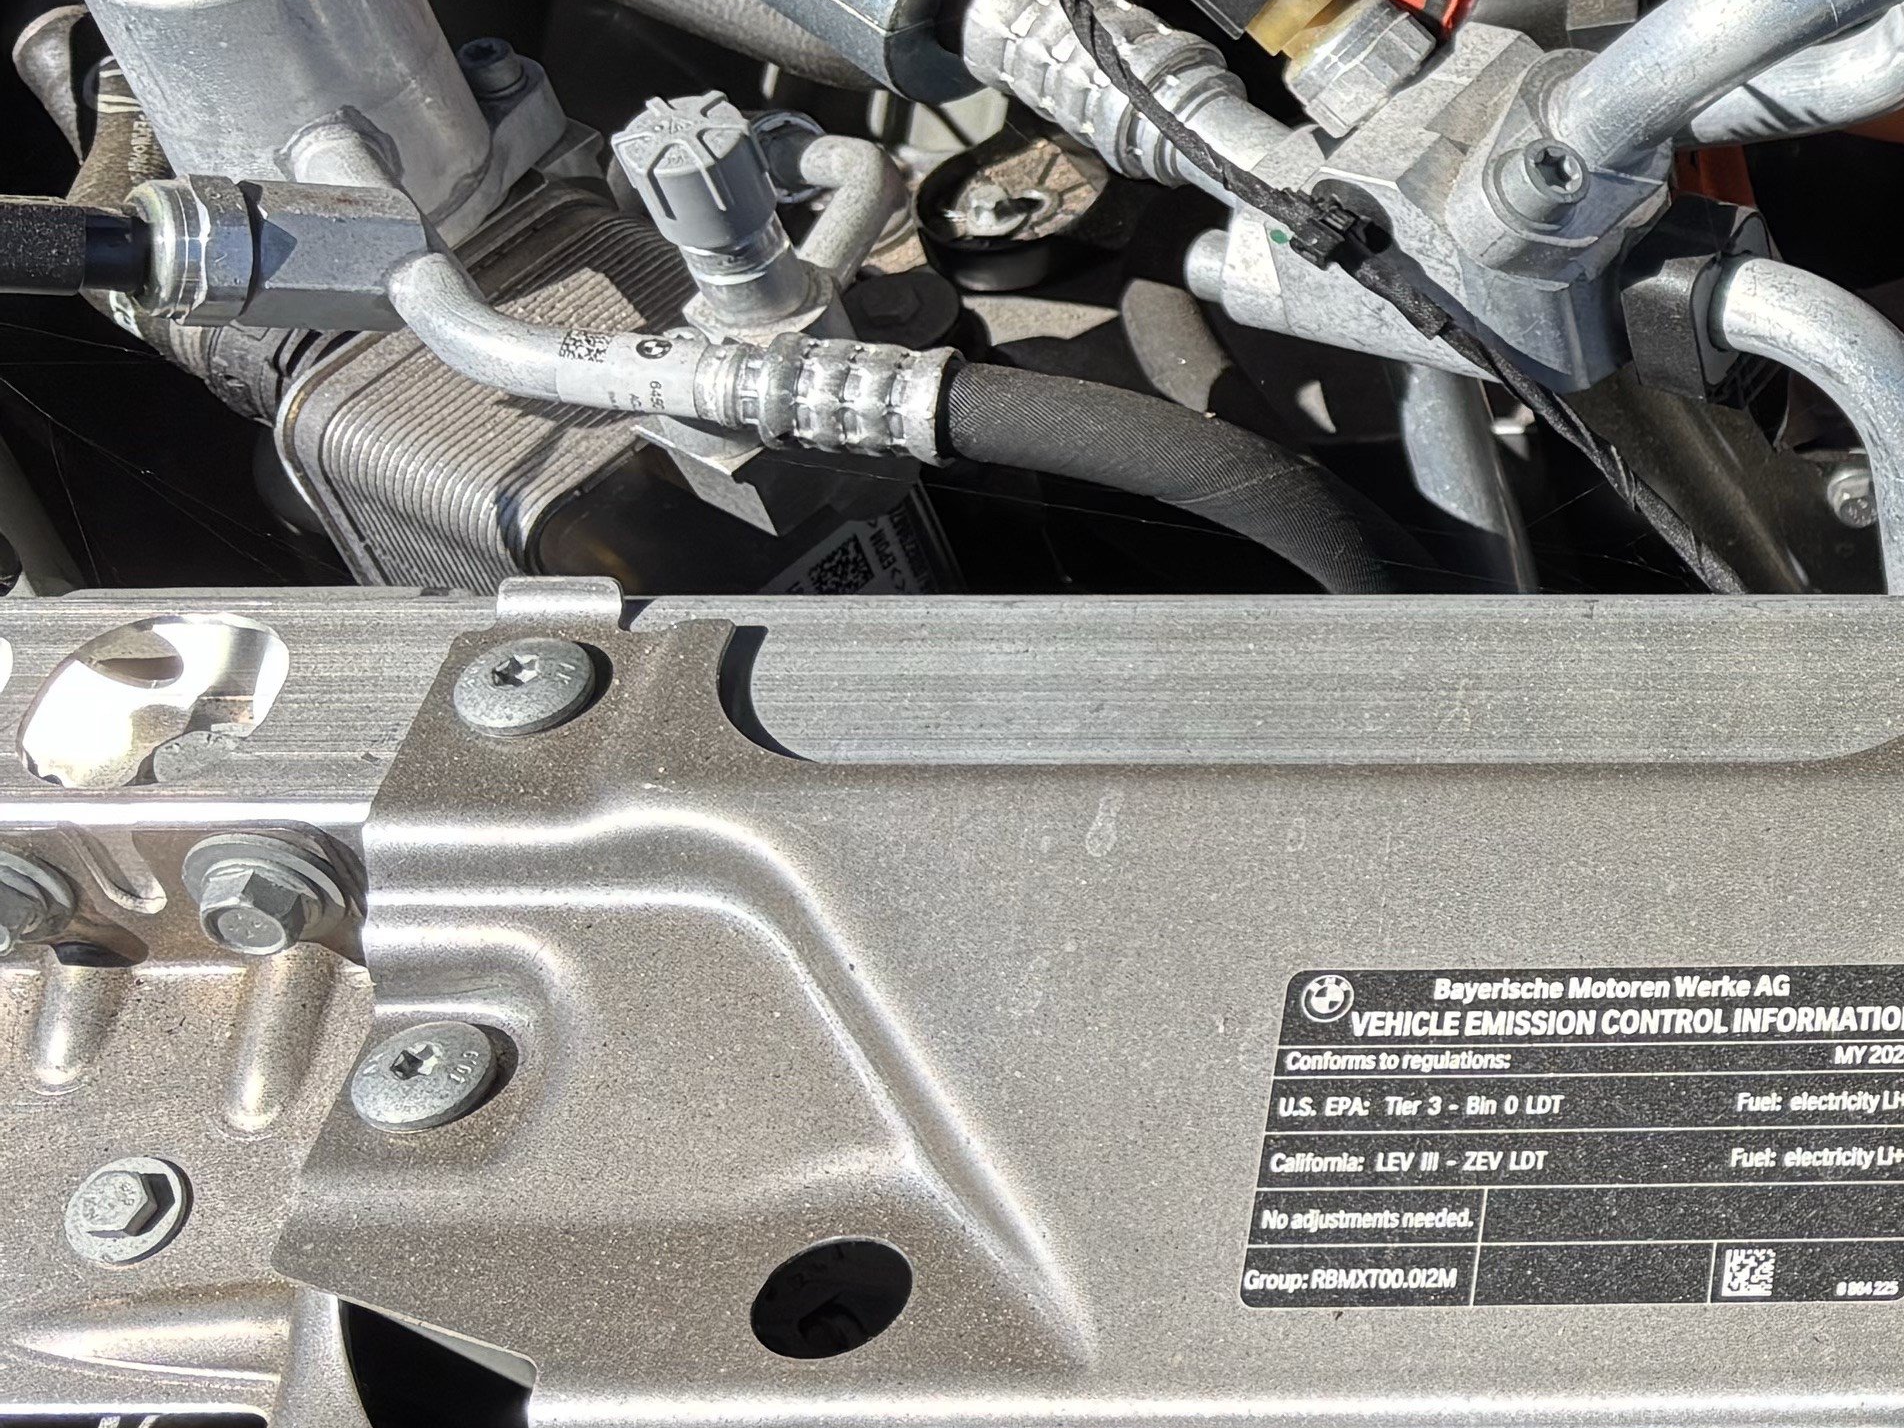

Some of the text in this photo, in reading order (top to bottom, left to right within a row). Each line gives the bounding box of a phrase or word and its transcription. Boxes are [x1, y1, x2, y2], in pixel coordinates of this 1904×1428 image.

[1434, 976, 1791, 1002] Bayerische Motoren Werke AG
[1352, 1011, 1461, 1038] VEHICLE
[1465, 1009, 1596, 1036] EMISSION
[1601, 1008, 1729, 1035] CONTROL
[1285, 1051, 1511, 1074] Conforms to regulations:
[1834, 1045, 1865, 1065] MY
[1279, 1096, 1317, 1117] U.S.
[1325, 1096, 1369, 1116] EPA:
[1385, 1095, 1419, 1115] Tier
[1427, 1096, 1441, 1115] 3
[1466, 1095, 1496, 1115] Bin
[1504, 1095, 1519, 1115] 0
[1526, 1094, 1564, 1114] LDT
[1736, 1092, 1782, 1112] Fuel:
[1790, 1091, 1881, 1115] electricity
[1270, 1151, 1364, 1173] California:
[1376, 1151, 1412, 1172] LEV
[1463, 1150, 1502, 1170] ZEV
[1509, 1150, 1548, 1170] LDT
[1730, 1147, 1776, 1168] Fuel:
[1784, 1146, 1875, 1170] electricity
[1260, 1207, 1475, 1233] No adjustments needed.
[1243, 1268, 1308, 1292] Group:
